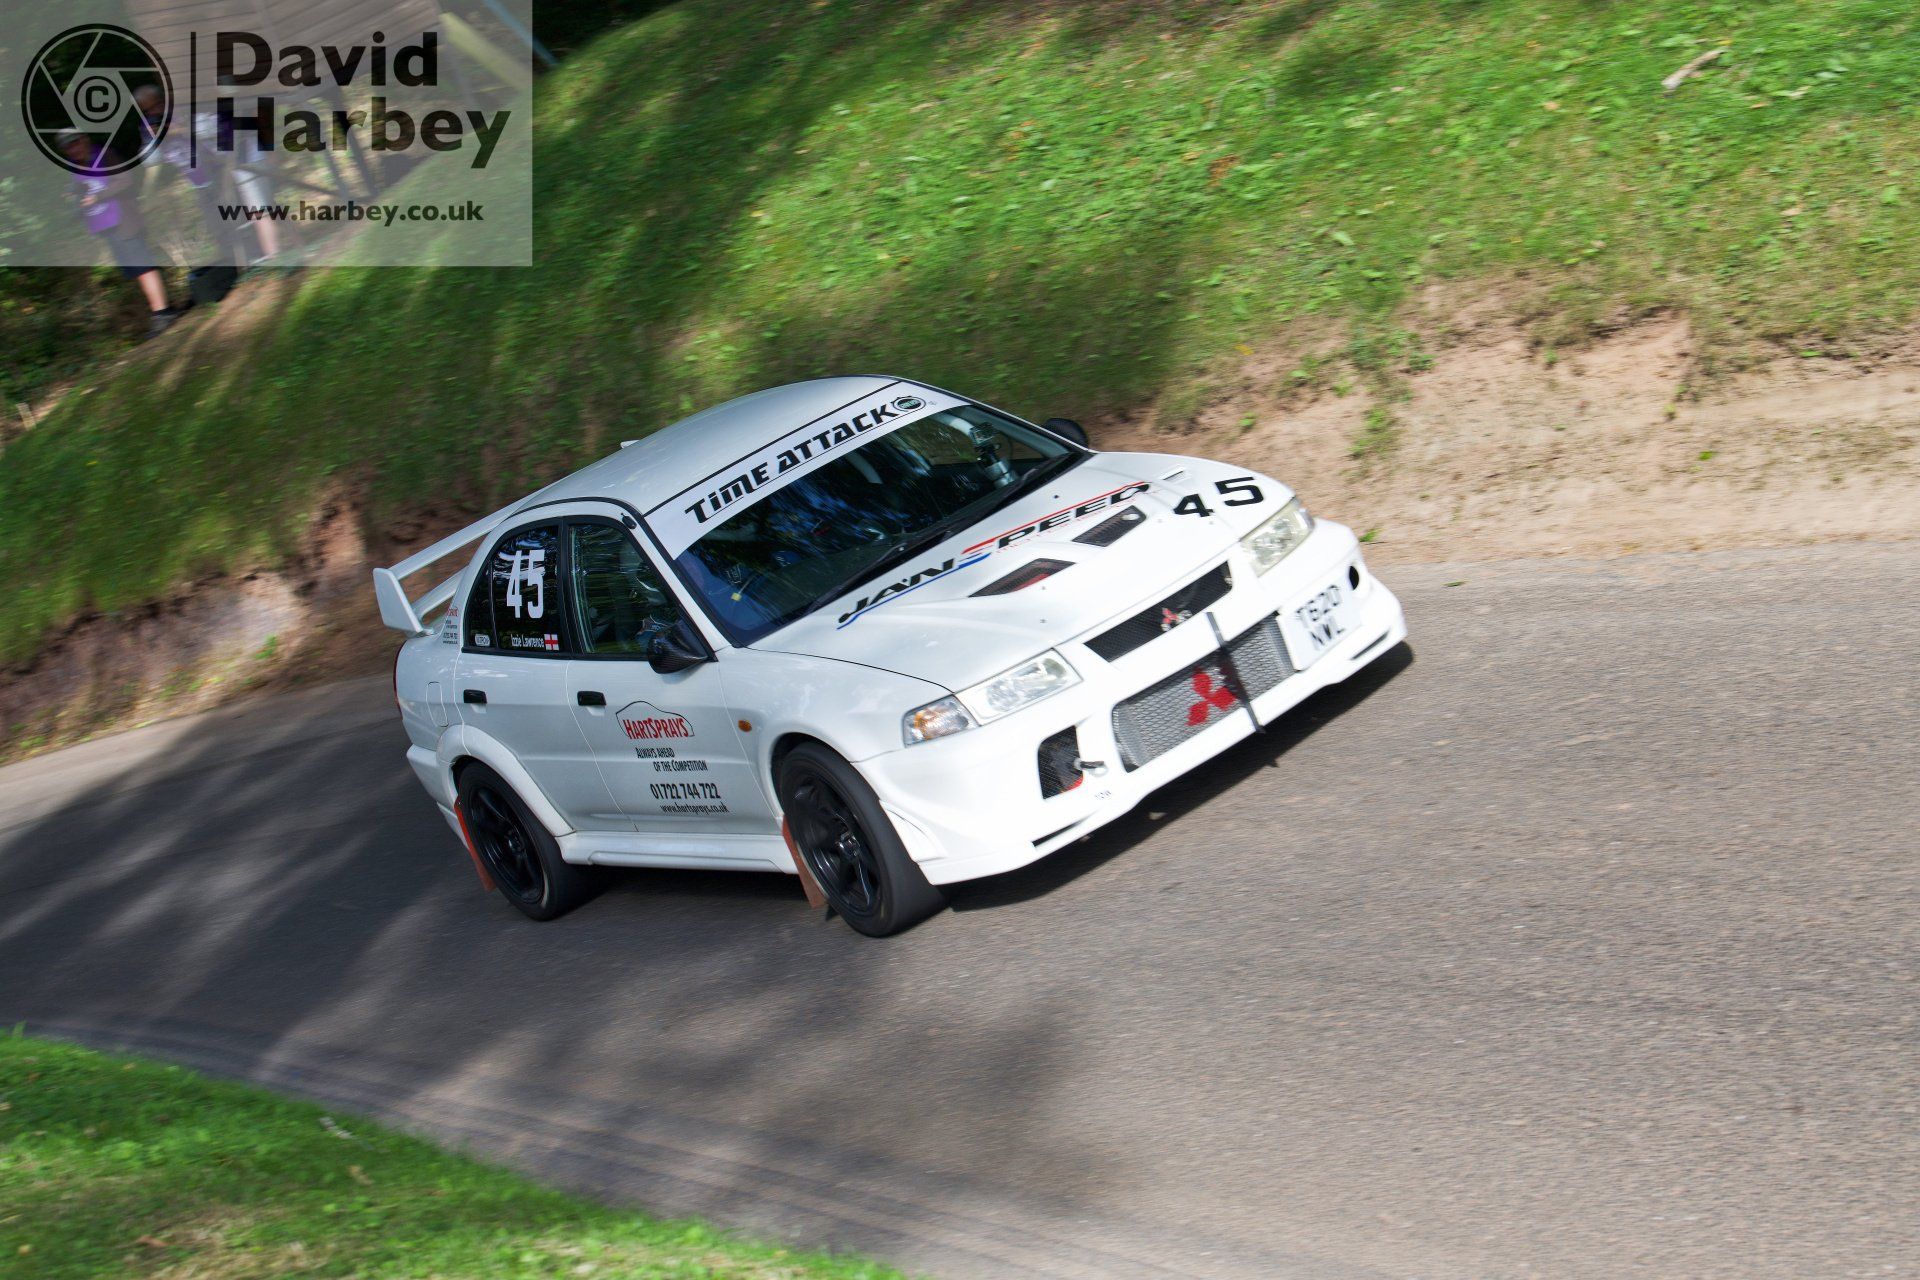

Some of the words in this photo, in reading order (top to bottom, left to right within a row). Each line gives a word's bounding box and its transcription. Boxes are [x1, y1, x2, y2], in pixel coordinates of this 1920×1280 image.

[776, 403, 899, 474] ATTACK
[1173, 476, 1265, 518] 45
[506, 549, 546, 619] 45
[522, 633, 545, 648] Lawrence
[622, 717, 690, 740] HARTSPRAYS
[635, 747, 657, 759] ALWAYS
[656, 747, 676, 759] AHEAD
[653, 761, 660, 772] OF
[660, 761, 672, 772] THE
[671, 759, 708, 772] COMPETITION
[650, 783, 681, 800] 01722
[680, 783, 700, 800] 744
[699, 783, 721, 799] 722
[660, 801, 730, 816] www.hartsprays.co.uk
